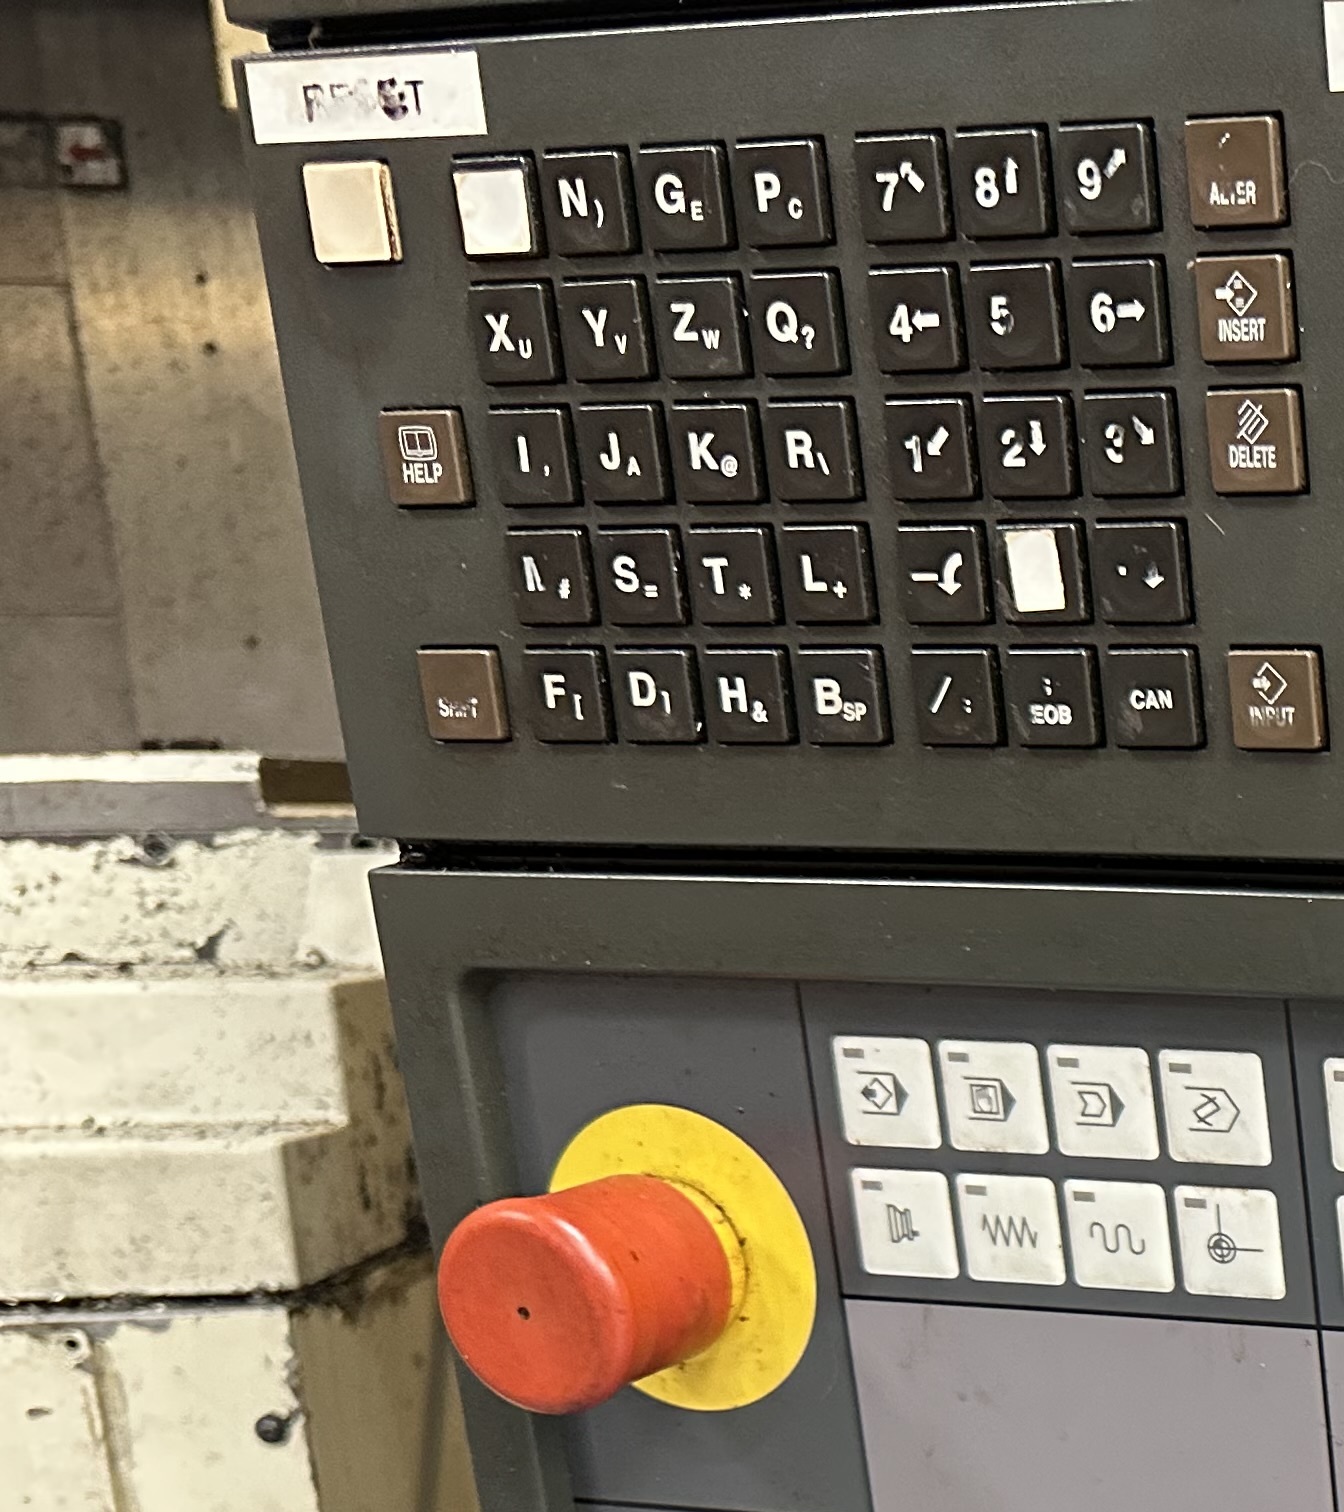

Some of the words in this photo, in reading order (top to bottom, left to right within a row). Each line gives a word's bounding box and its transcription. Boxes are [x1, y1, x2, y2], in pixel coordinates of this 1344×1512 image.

[875, 172, 900, 212] 7
[974, 166, 1000, 208] 8
[1077, 158, 1102, 200] 9
[889, 304, 914, 343] 4
[1090, 292, 1116, 333] 6
[1217, 317, 1267, 342] INSERT
[1001, 428, 1026, 468] 2
[1228, 444, 1277, 469] DELETE
[402, 462, 443, 484] HELP
[1029, 703, 1073, 725] EOB
[1129, 689, 1173, 710] CAN
